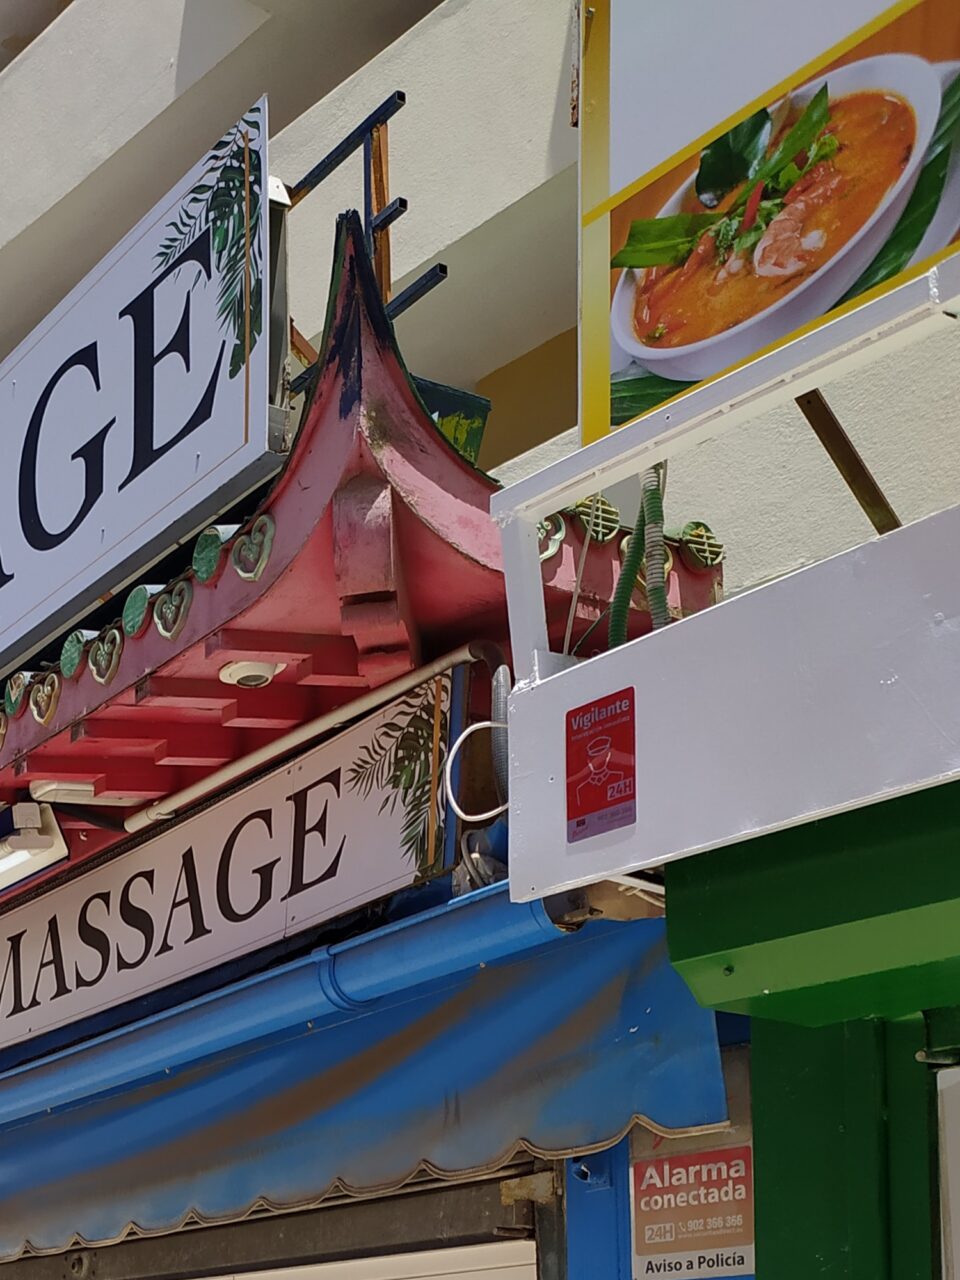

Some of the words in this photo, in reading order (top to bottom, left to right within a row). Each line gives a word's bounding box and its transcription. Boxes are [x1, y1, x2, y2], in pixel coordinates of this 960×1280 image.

[571, 699, 630, 730] Vigilante
[608, 781, 633, 798] 24H
[640, 1159, 746, 1190] Alarma
[640, 1180, 746, 1211] conectada
[647, 1224, 673, 1241] 24H
[687, 1218, 704, 1231] 902
[706, 1216, 724, 1230] 366
[726, 1214, 743, 1228] 366
[645, 1259, 682, 1274] Aviso
[686, 1259, 694, 1270] a
[698, 1252, 745, 1270] Policía
